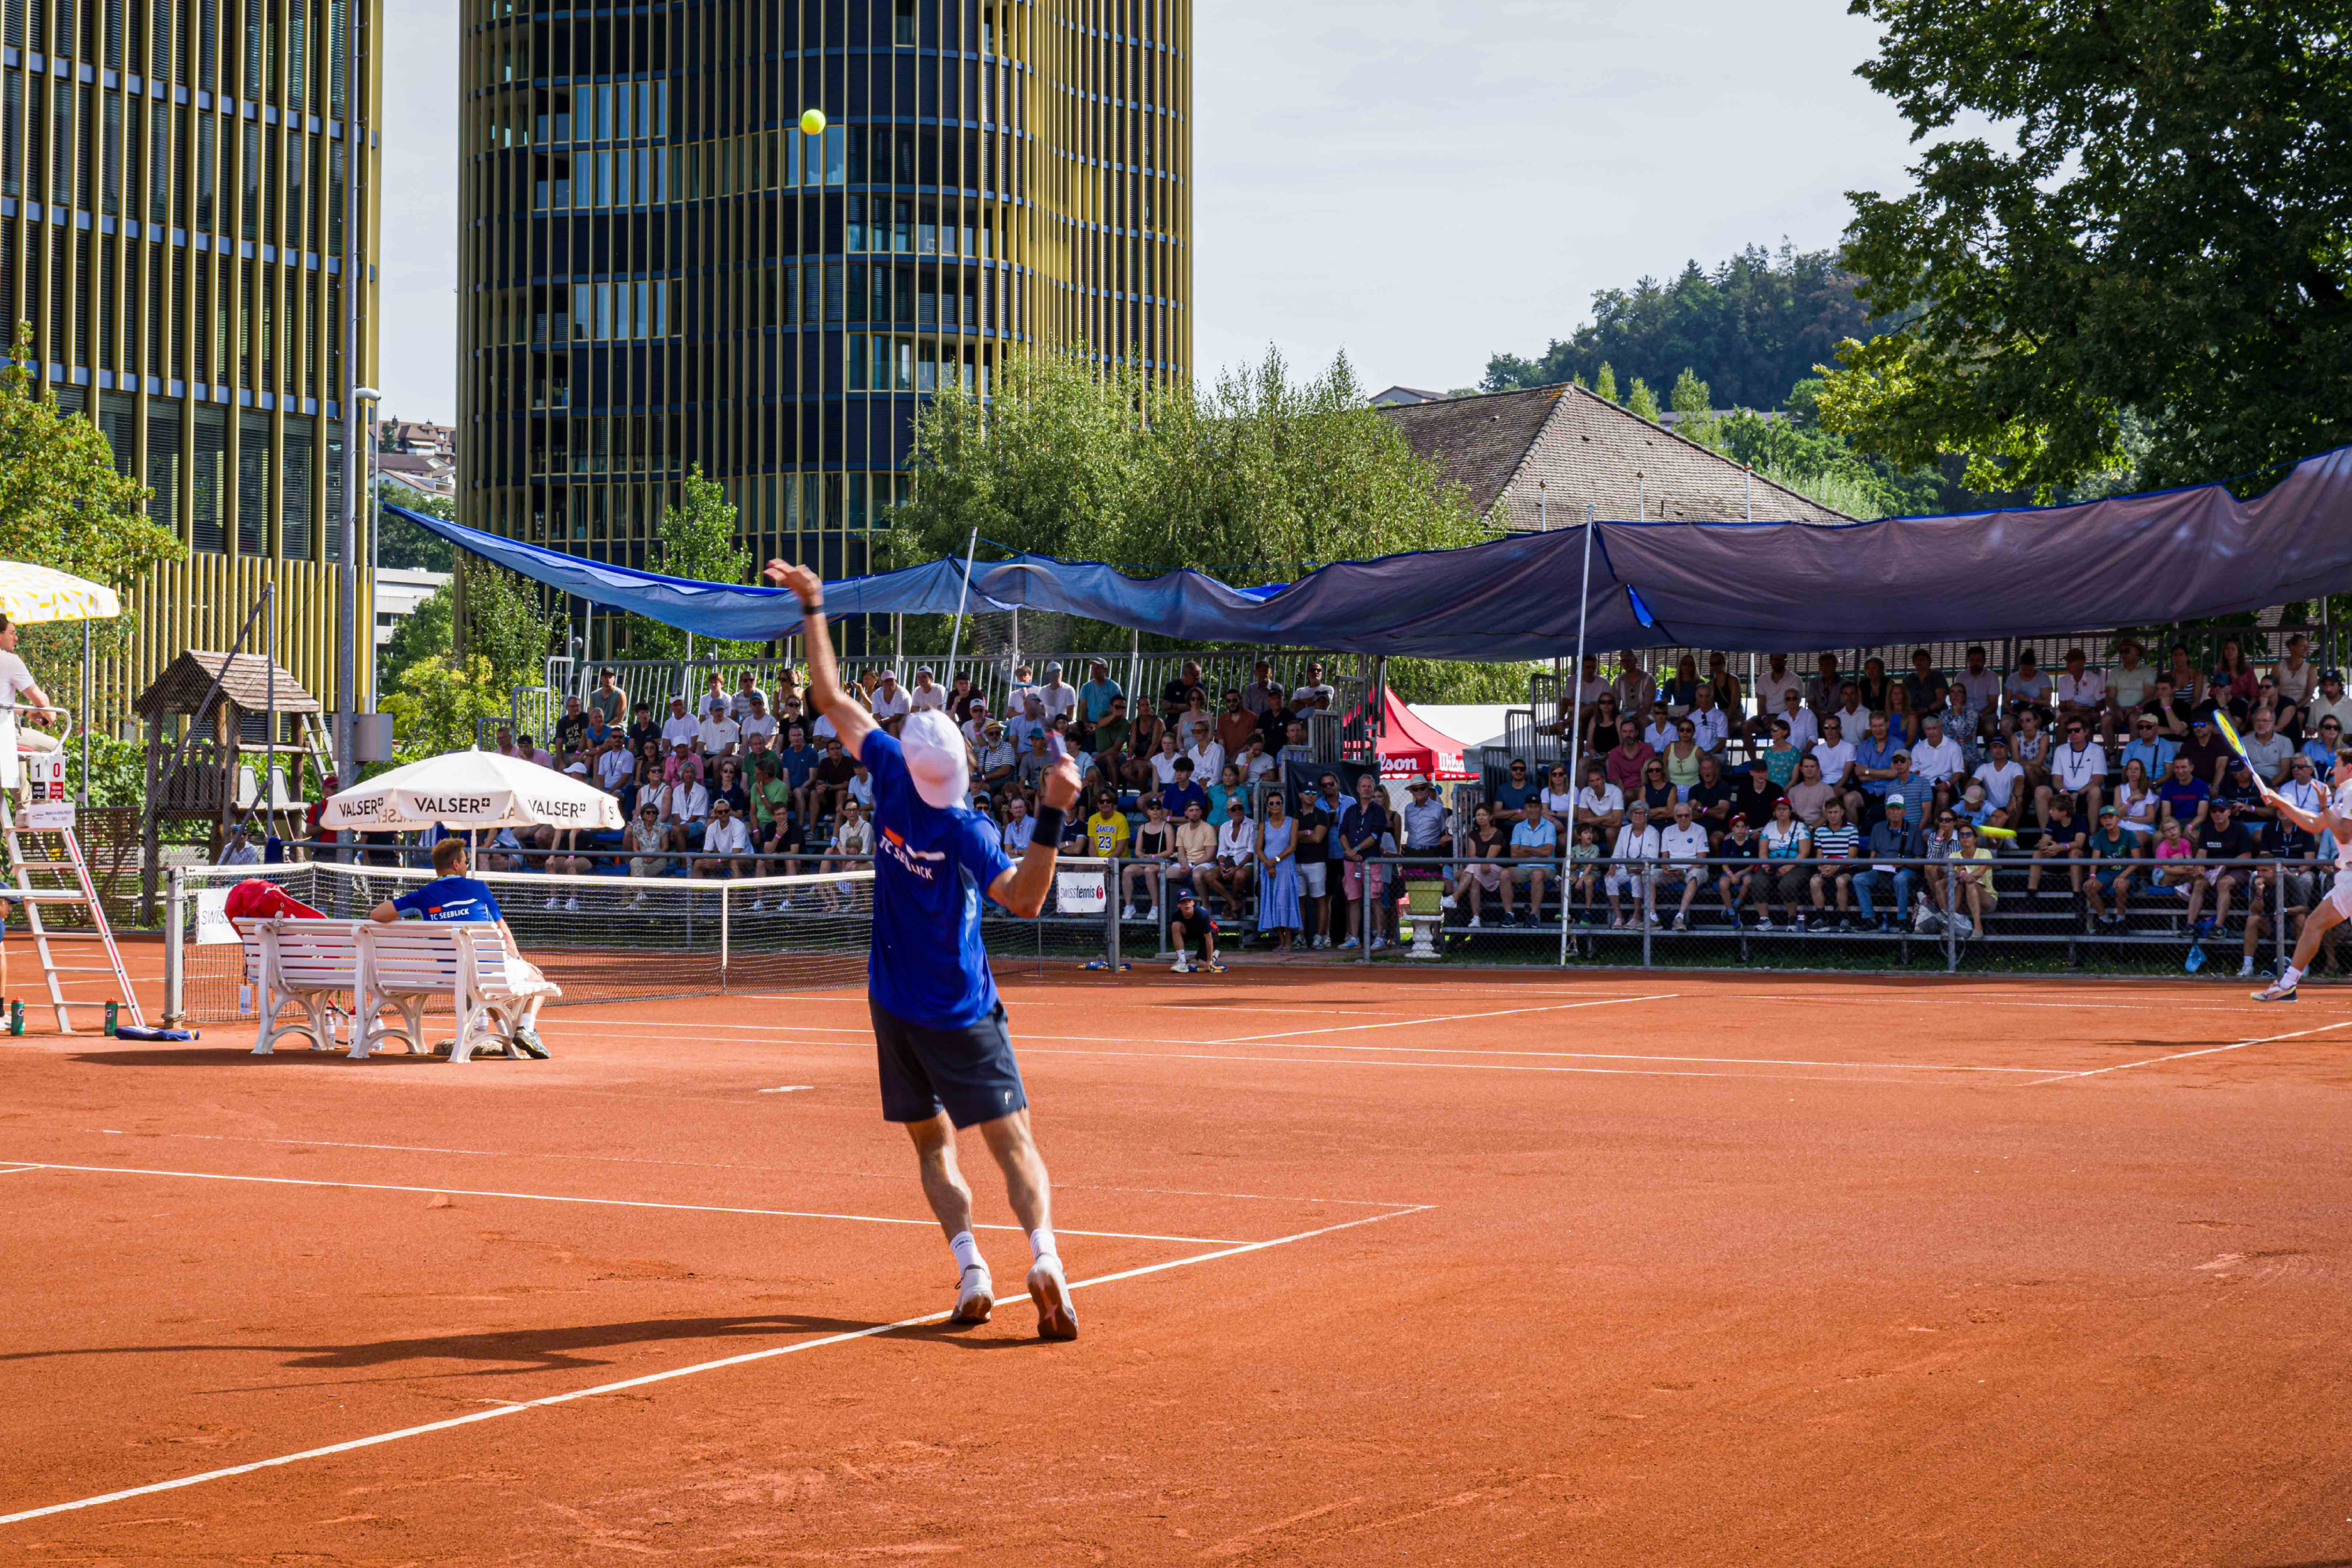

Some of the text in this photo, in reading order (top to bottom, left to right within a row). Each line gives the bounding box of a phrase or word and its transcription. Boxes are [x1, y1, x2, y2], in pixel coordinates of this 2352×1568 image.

[1378, 753, 1418, 770] lson
[1438, 753, 1466, 772] Wilso
[35, 763, 40, 777] 1
[53, 763, 60, 777] 0
[339, 799, 378, 818] VALSER
[414, 797, 480, 813] VALSER
[527, 799, 578, 818] VALSER
[1095, 824, 1116, 833] LAKERS
[1098, 835, 1112, 849] 23
[1060, 885, 1095, 899] swisstennis
[201, 906, 230, 925] swis
[439, 908, 470, 920] SEEBLICK
